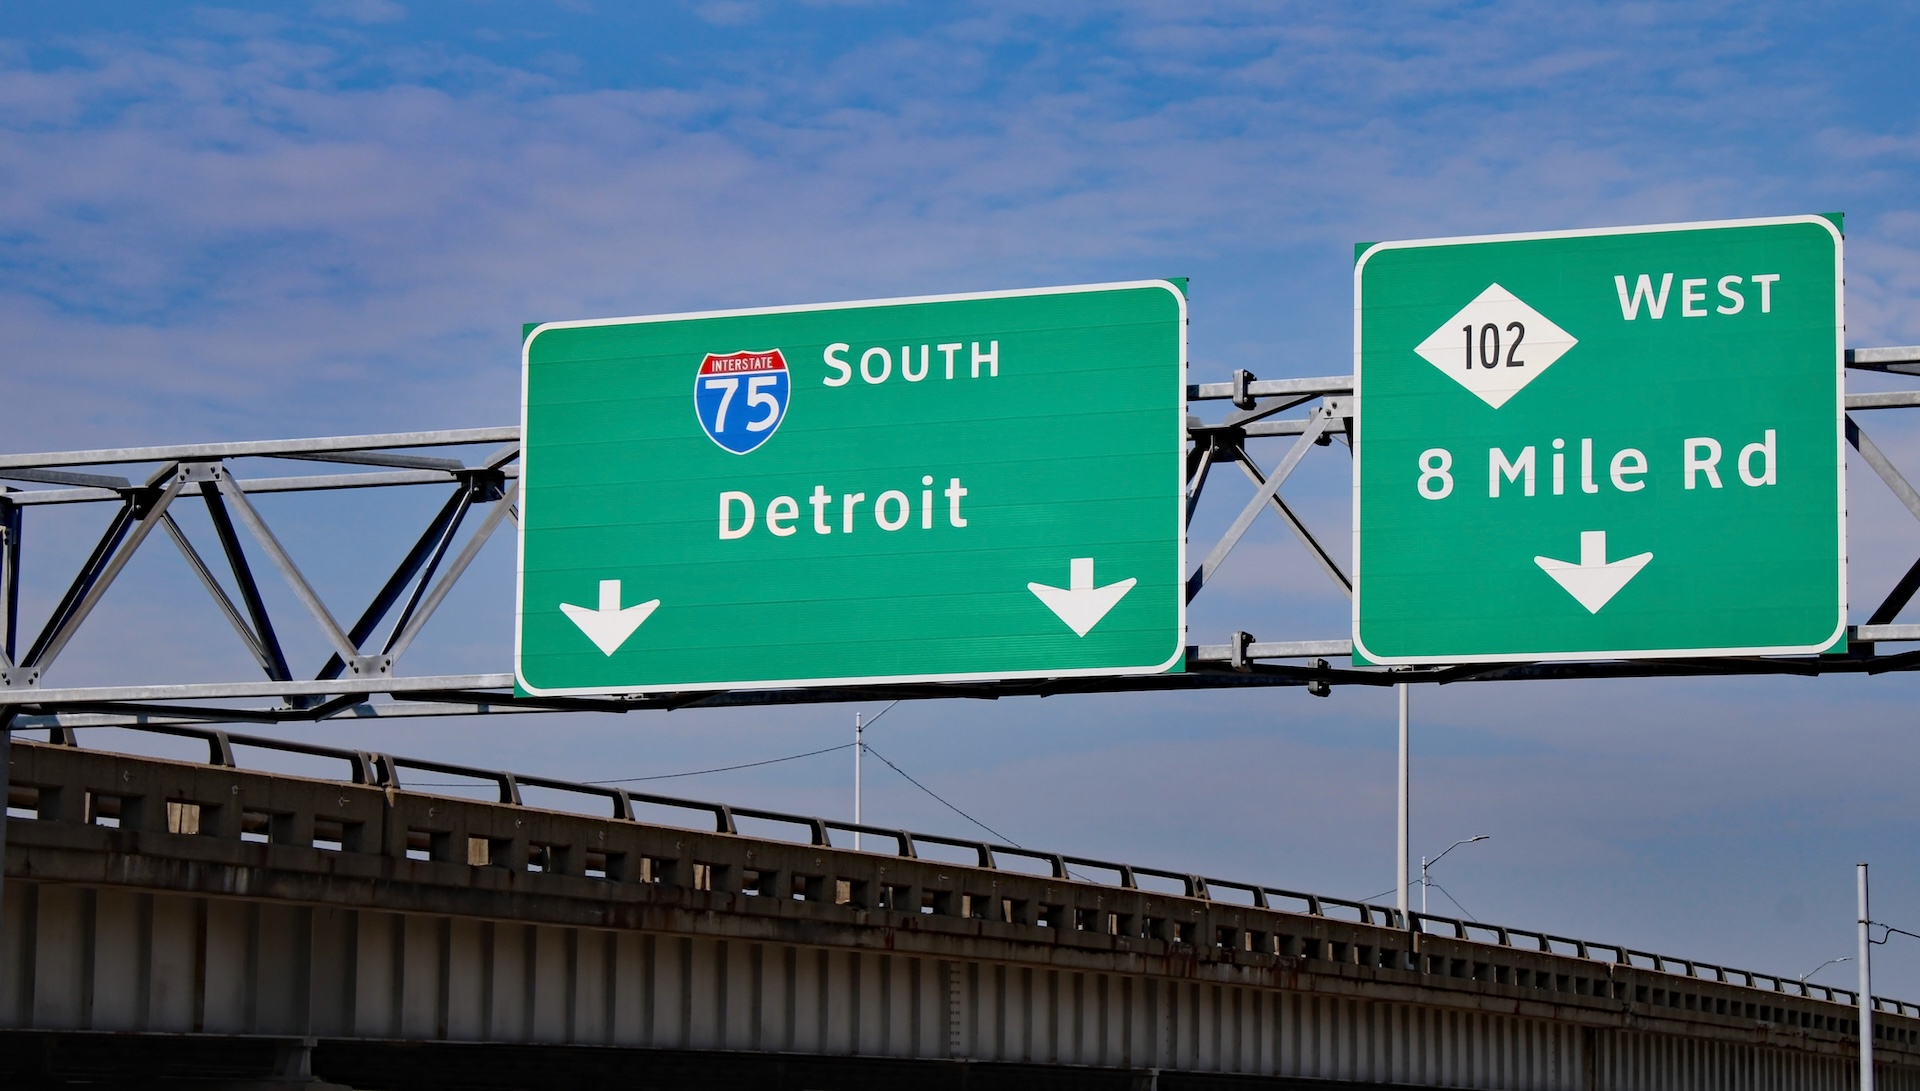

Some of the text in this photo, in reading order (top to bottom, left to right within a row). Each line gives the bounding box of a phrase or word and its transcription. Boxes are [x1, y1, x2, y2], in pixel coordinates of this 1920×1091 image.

[1614, 272, 1781, 321] WEST
[711, 356, 774, 372] INTERSTATE
[822, 340, 1000, 387] SOUTH
[1462, 321, 1526, 370] 102
[704, 375, 780, 433] 75
[1417, 429, 1777, 501] 8 Mile Rd
[718, 475, 968, 540] Detroit
